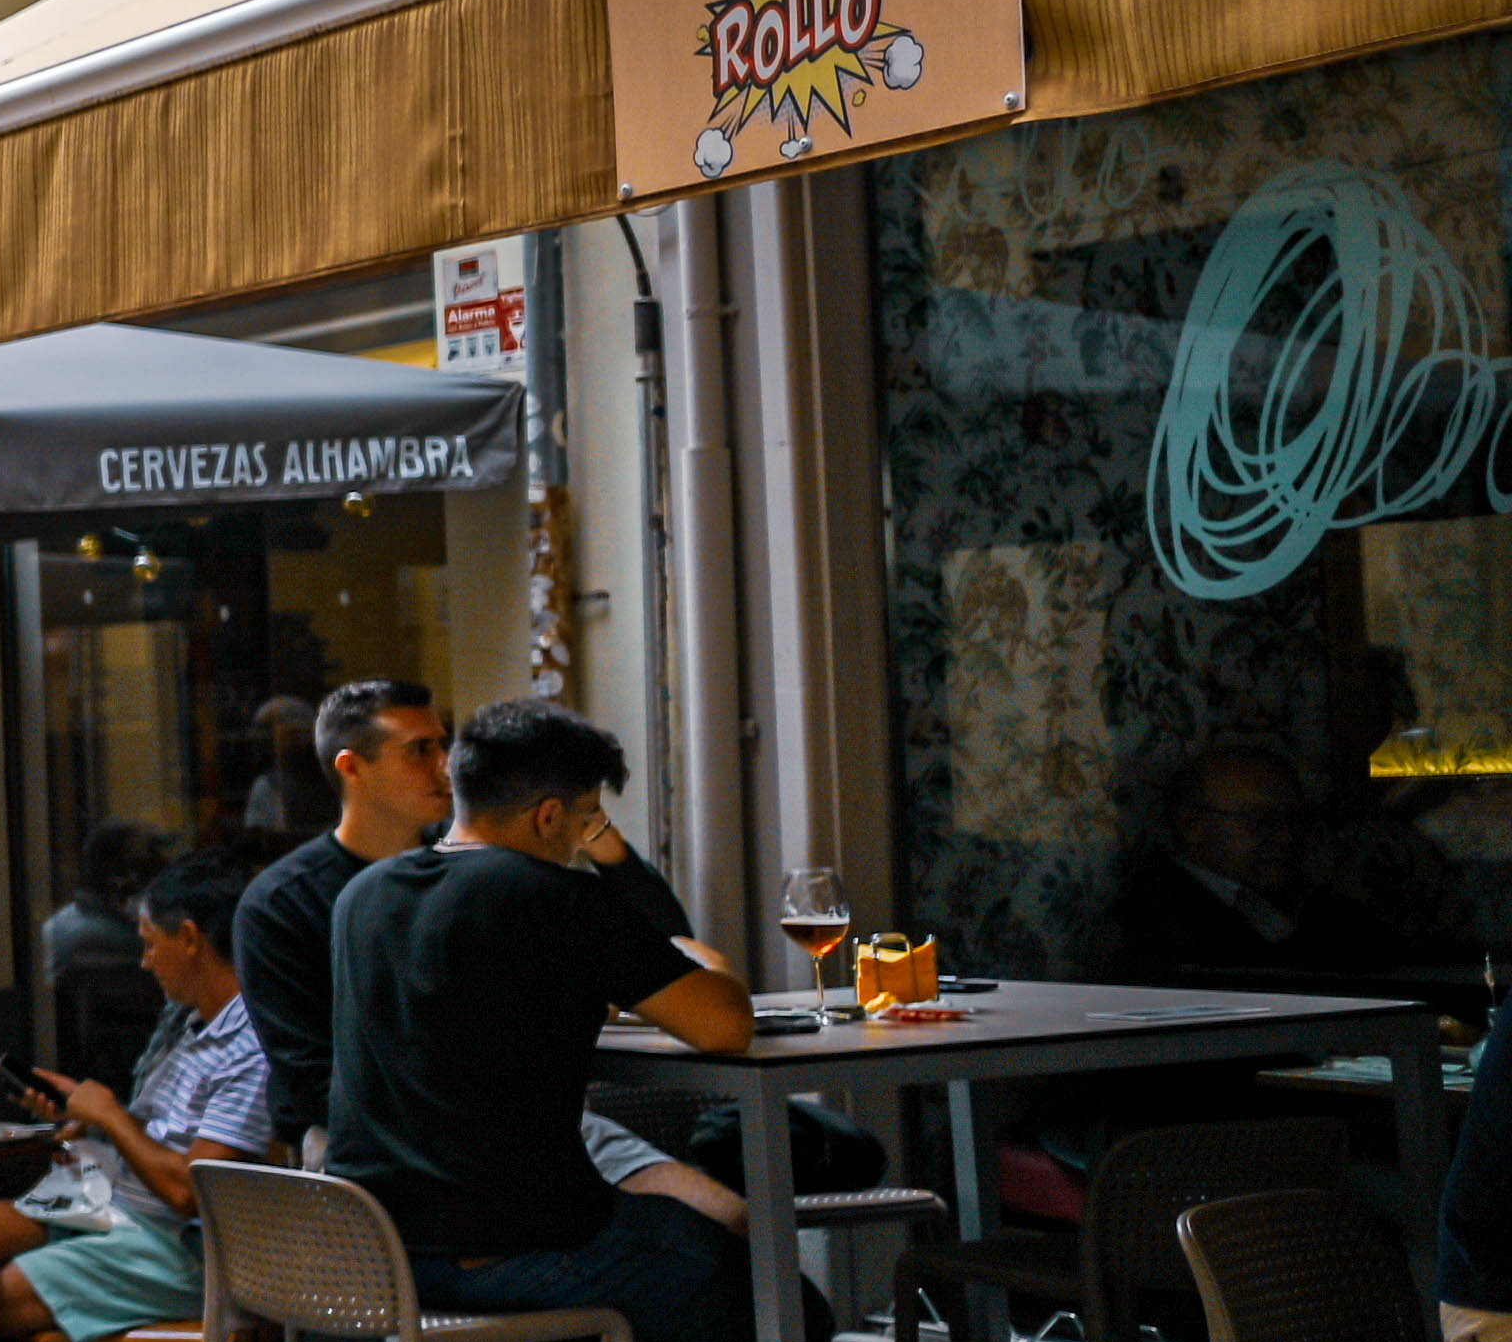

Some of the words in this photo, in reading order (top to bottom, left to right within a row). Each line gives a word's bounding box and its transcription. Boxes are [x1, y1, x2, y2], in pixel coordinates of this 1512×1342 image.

[448, 307, 495, 324] Alarma
[99, 442, 268, 494] CERVEZAS
[283, 434, 474, 485] ALHAMBRA
